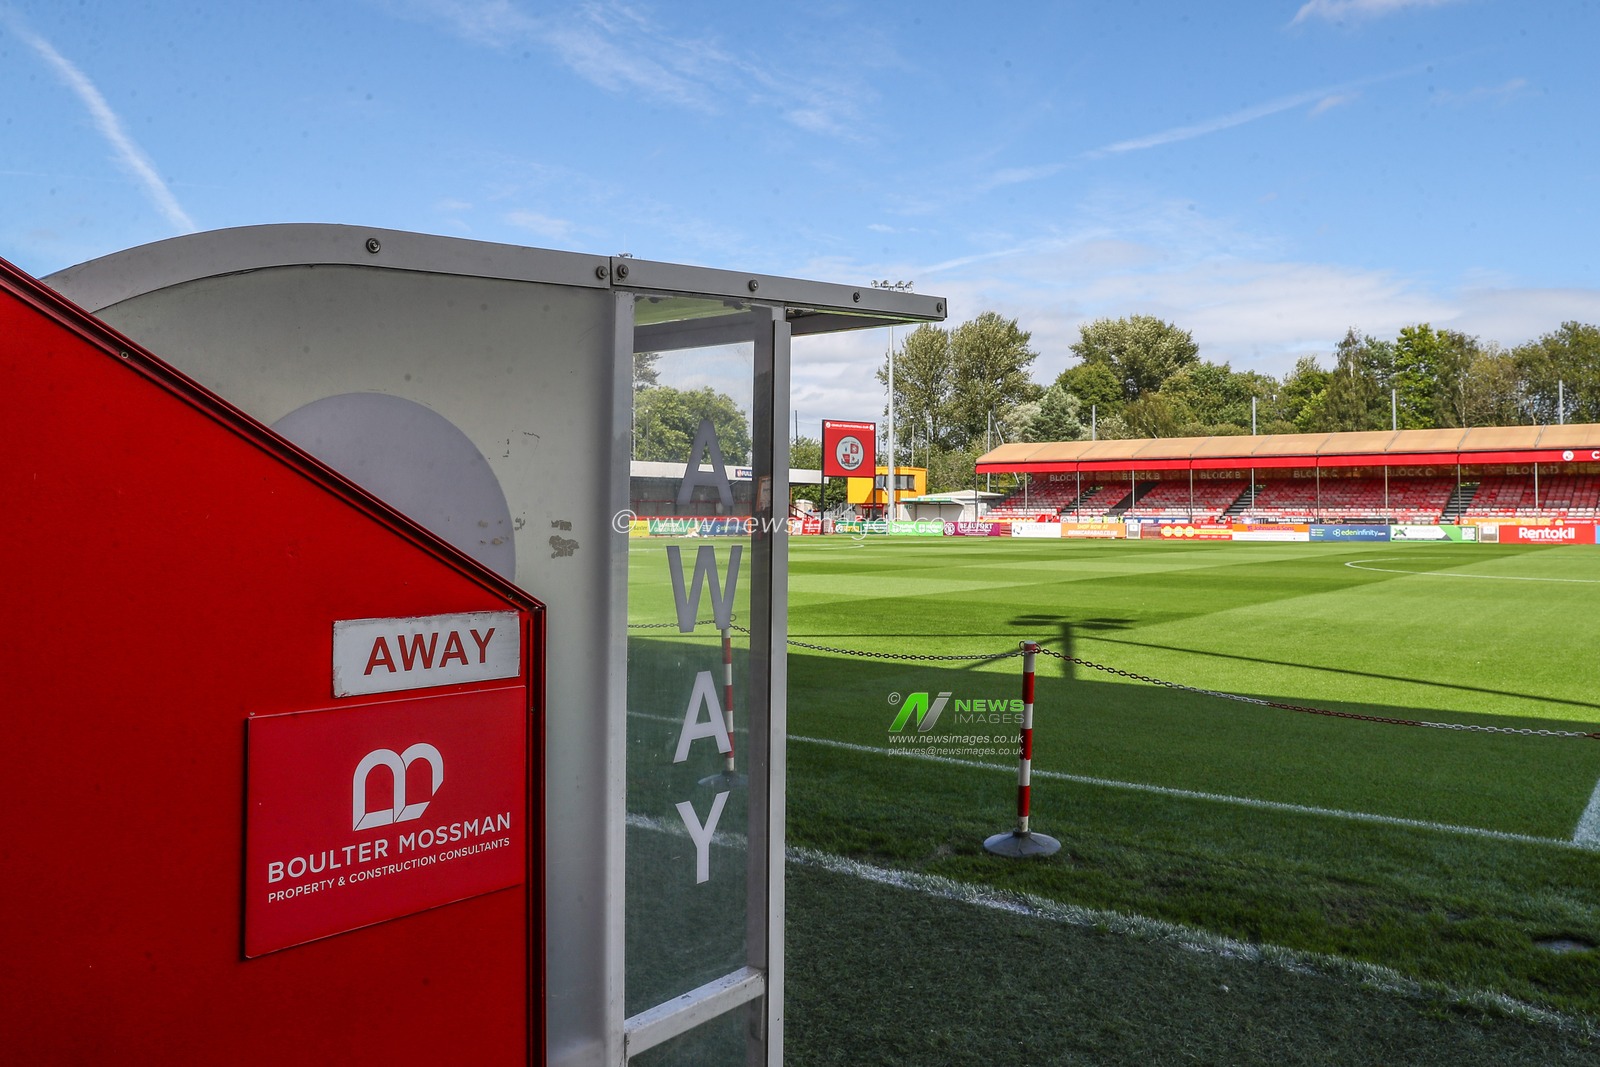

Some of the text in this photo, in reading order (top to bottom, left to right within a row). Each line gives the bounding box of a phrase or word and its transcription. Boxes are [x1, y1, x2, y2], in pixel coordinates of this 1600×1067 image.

[1293, 469, 1328, 478] BLOCK
[1386, 467, 1423, 477] BLOCK
[1506, 465, 1547, 475] BLOCK
[1049, 474, 1085, 482] BLOCK A
[1122, 472, 1152, 481] BLOCK
[1200, 471, 1241, 480] BLOCK B
[1518, 527, 1575, 539] Rentokil
[363, 627, 496, 676] AWAY
[268, 812, 511, 884] BOULTER MOSSMAN
[268, 837, 510, 903] PROPERTY & CONSTRUCTION CONSULTANTS
